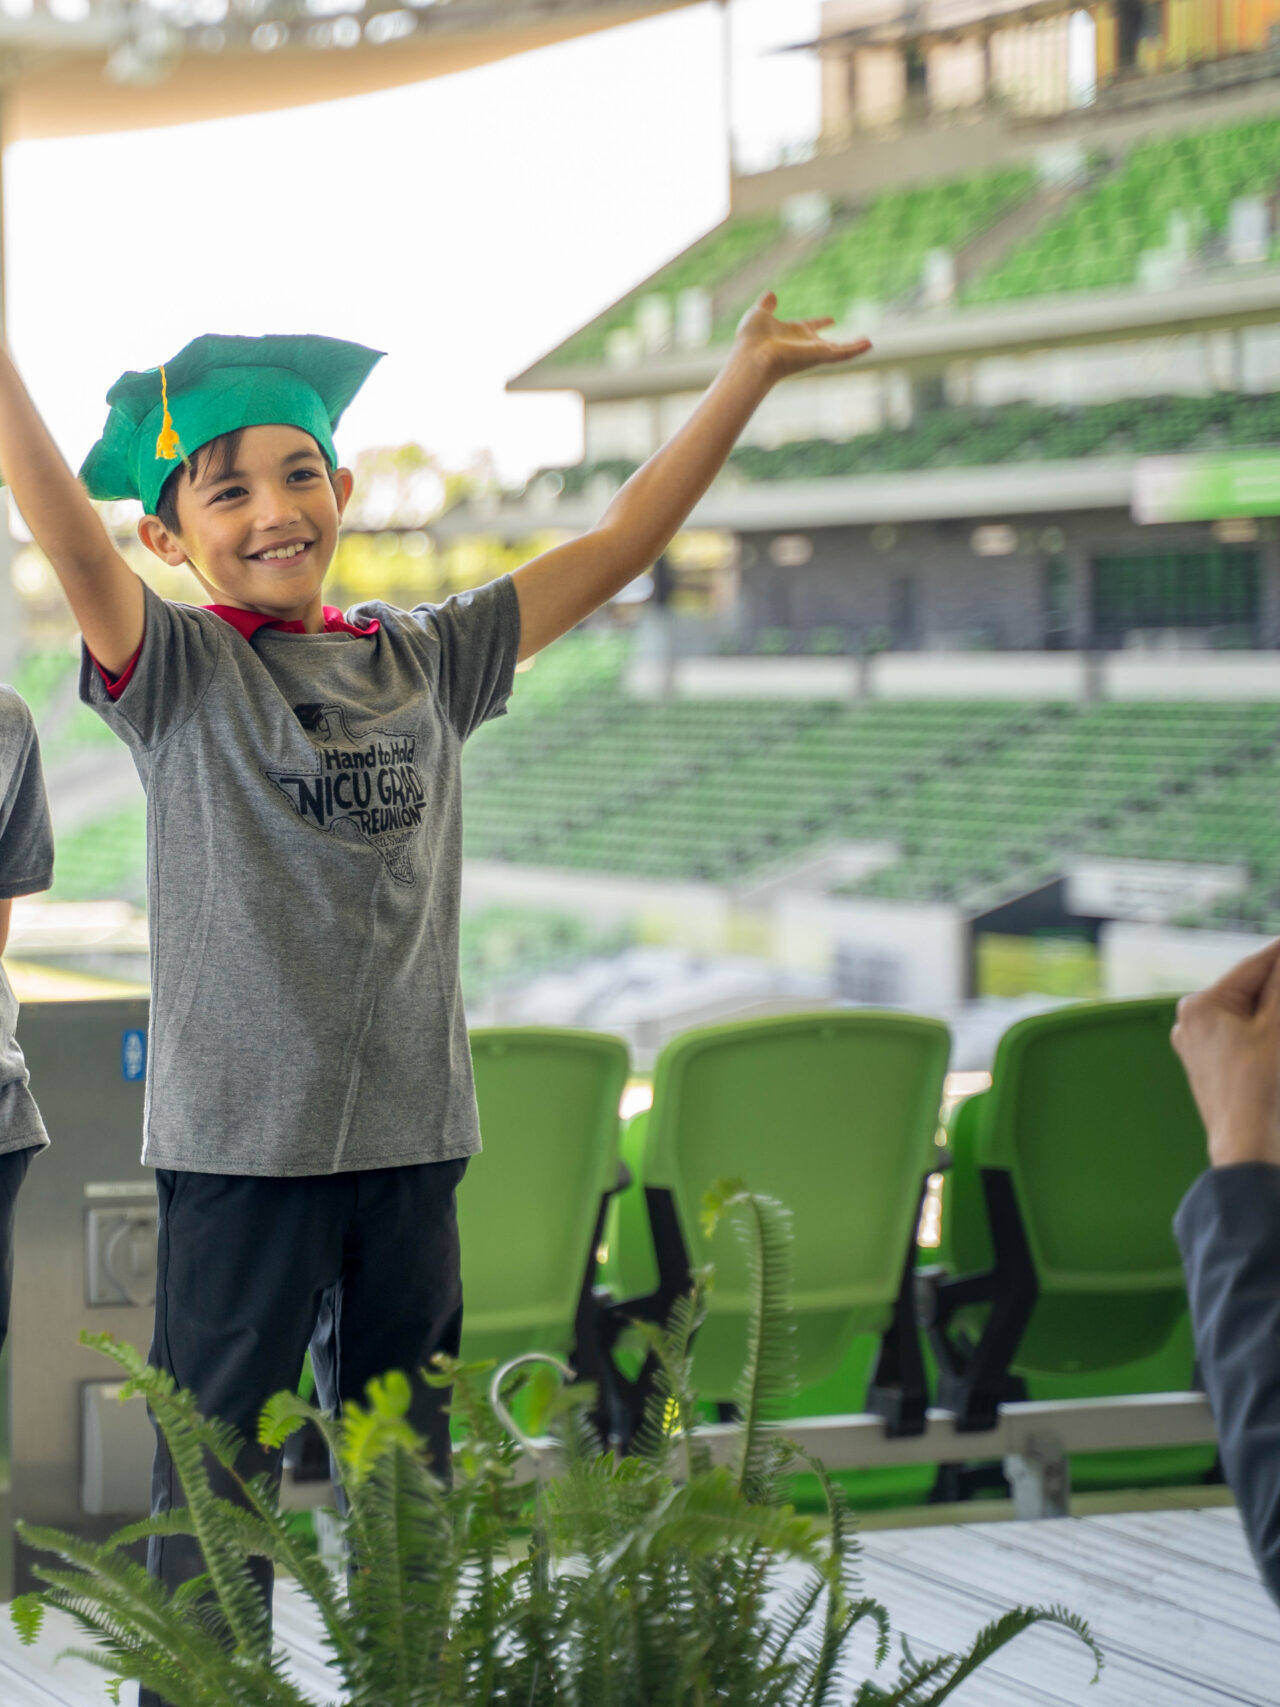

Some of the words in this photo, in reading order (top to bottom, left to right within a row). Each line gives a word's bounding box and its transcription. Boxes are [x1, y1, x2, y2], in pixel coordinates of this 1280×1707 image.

[324, 745, 376, 770] Hand
[378, 742, 391, 766] to
[391, 738, 416, 765] Hold
[280, 770, 371, 826] NICU
[377, 765, 424, 808] GRAD
[348, 802, 427, 836] REUNION
